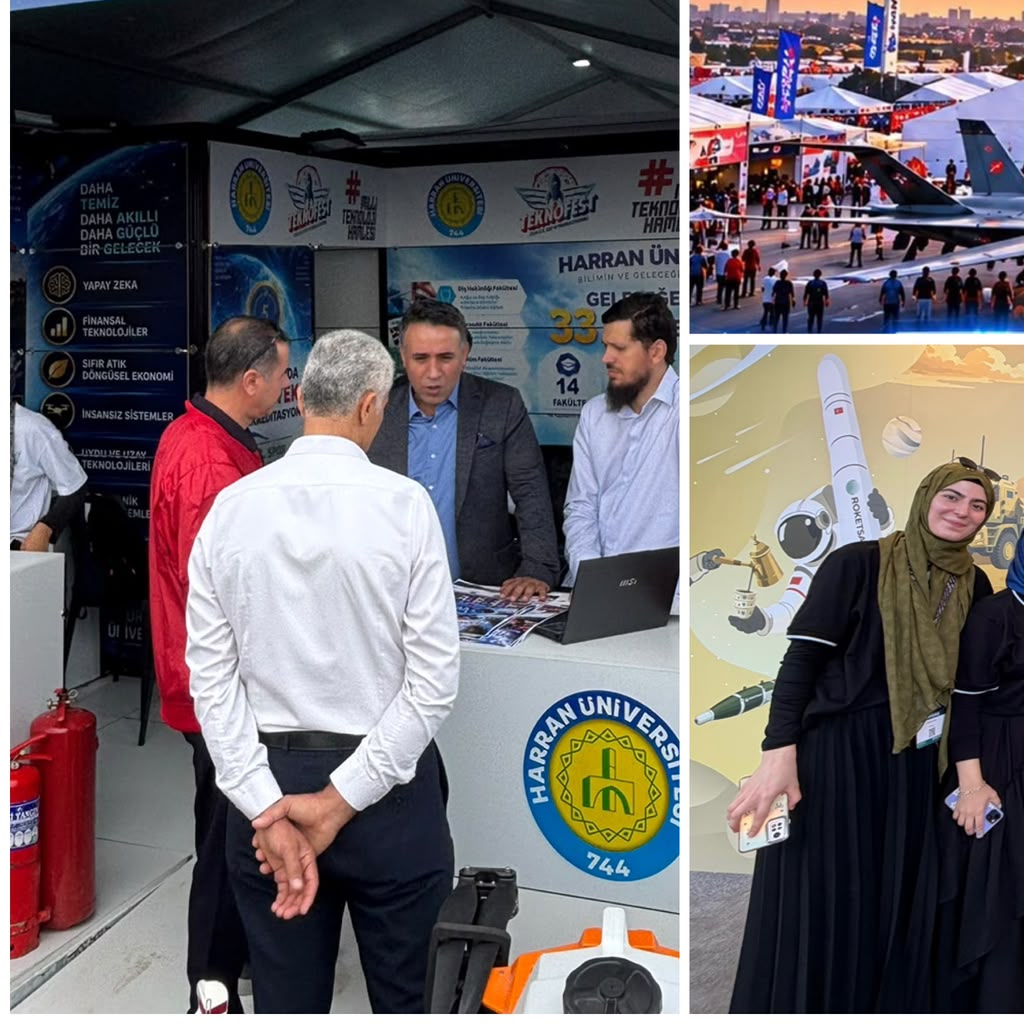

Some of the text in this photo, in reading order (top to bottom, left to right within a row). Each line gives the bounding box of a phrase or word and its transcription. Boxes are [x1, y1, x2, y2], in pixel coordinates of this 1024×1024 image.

[80, 182, 113, 196] DAHA
[80, 194, 119, 210] TEMİZ
[80, 210, 158, 226] DAHA AKILLI
[288, 199, 332, 233] TEKNOFEST
[520, 193, 599, 233] TEKNOFEST
[80, 223, 159, 241] DAHA GÜÇLÜ
[103, 240, 161, 256] GELECEK
[558, 248, 644, 274] HARRAN
[617, 271, 630, 281] VE
[83, 280, 138, 291] YAPAY ZEKA
[82, 314, 126, 326] FİNANSAL
[549, 307, 598, 346] 33
[83, 326, 148, 337] TEKNOLOJİLER
[82, 359, 127, 368] SIFIR ATIK
[82, 369, 174, 381] DÖNGÜSEL EKONOMİ
[556, 377, 580, 395] 14
[82, 407, 174, 421] İNSANSIZ SİSTEMLER
[82, 459, 151, 472] TEKNOLOJİLERİ
[851, 496, 866, 543] ROKETSA
[528, 702, 578, 804] HARRAN
[586, 851, 631, 877] 744
